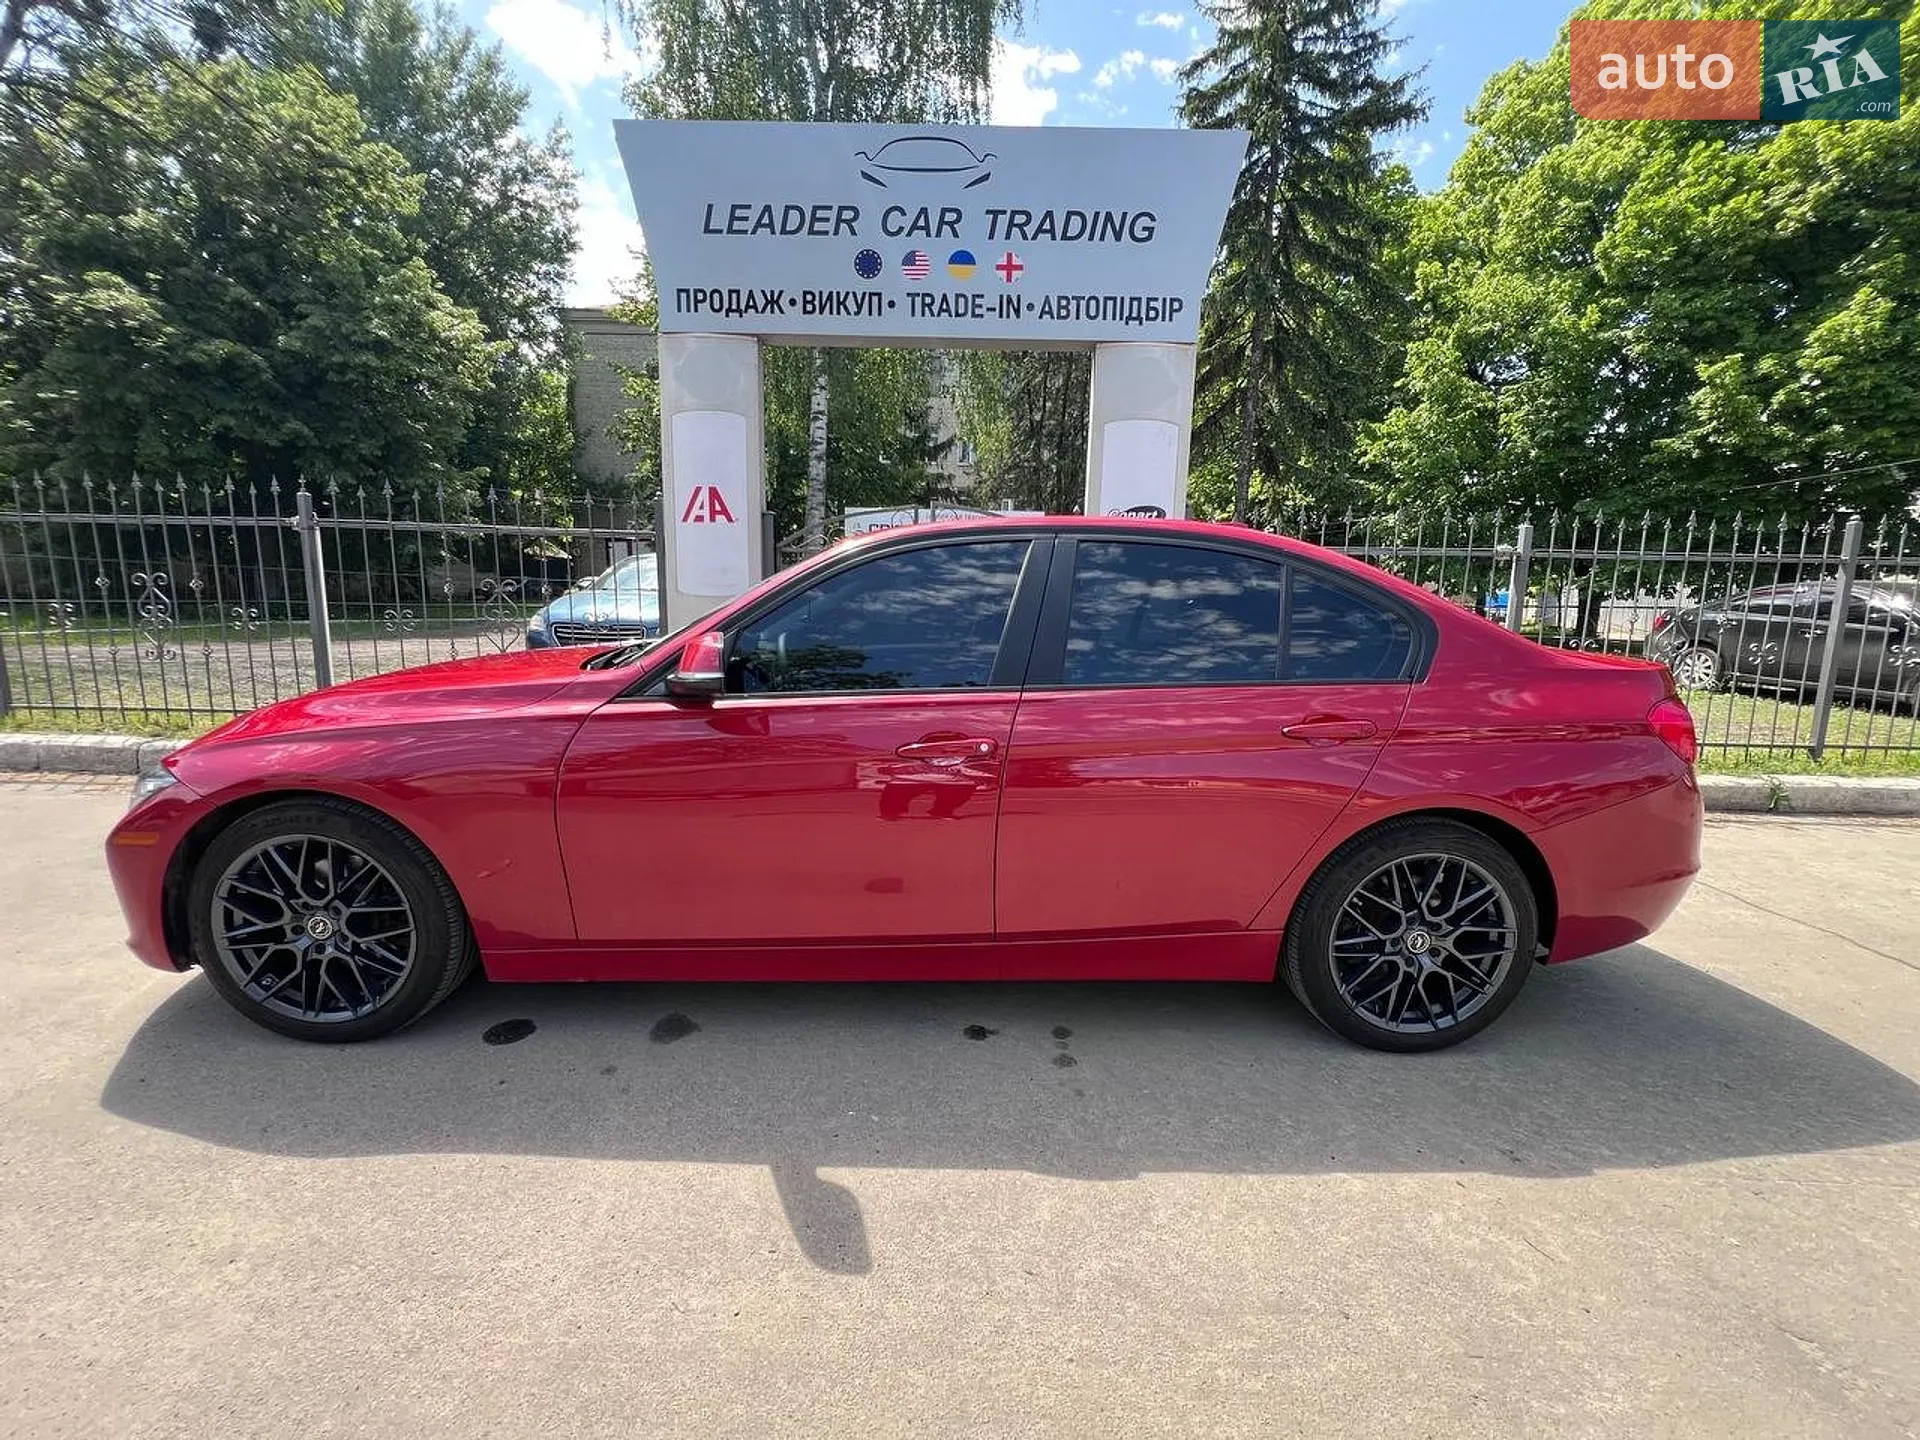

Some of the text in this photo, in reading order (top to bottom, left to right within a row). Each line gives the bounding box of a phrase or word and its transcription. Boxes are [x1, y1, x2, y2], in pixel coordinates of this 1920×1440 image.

[703, 204, 1157, 242] LEADER CAR TRADING
[906, 292, 1022, 319] TRADE-IN
